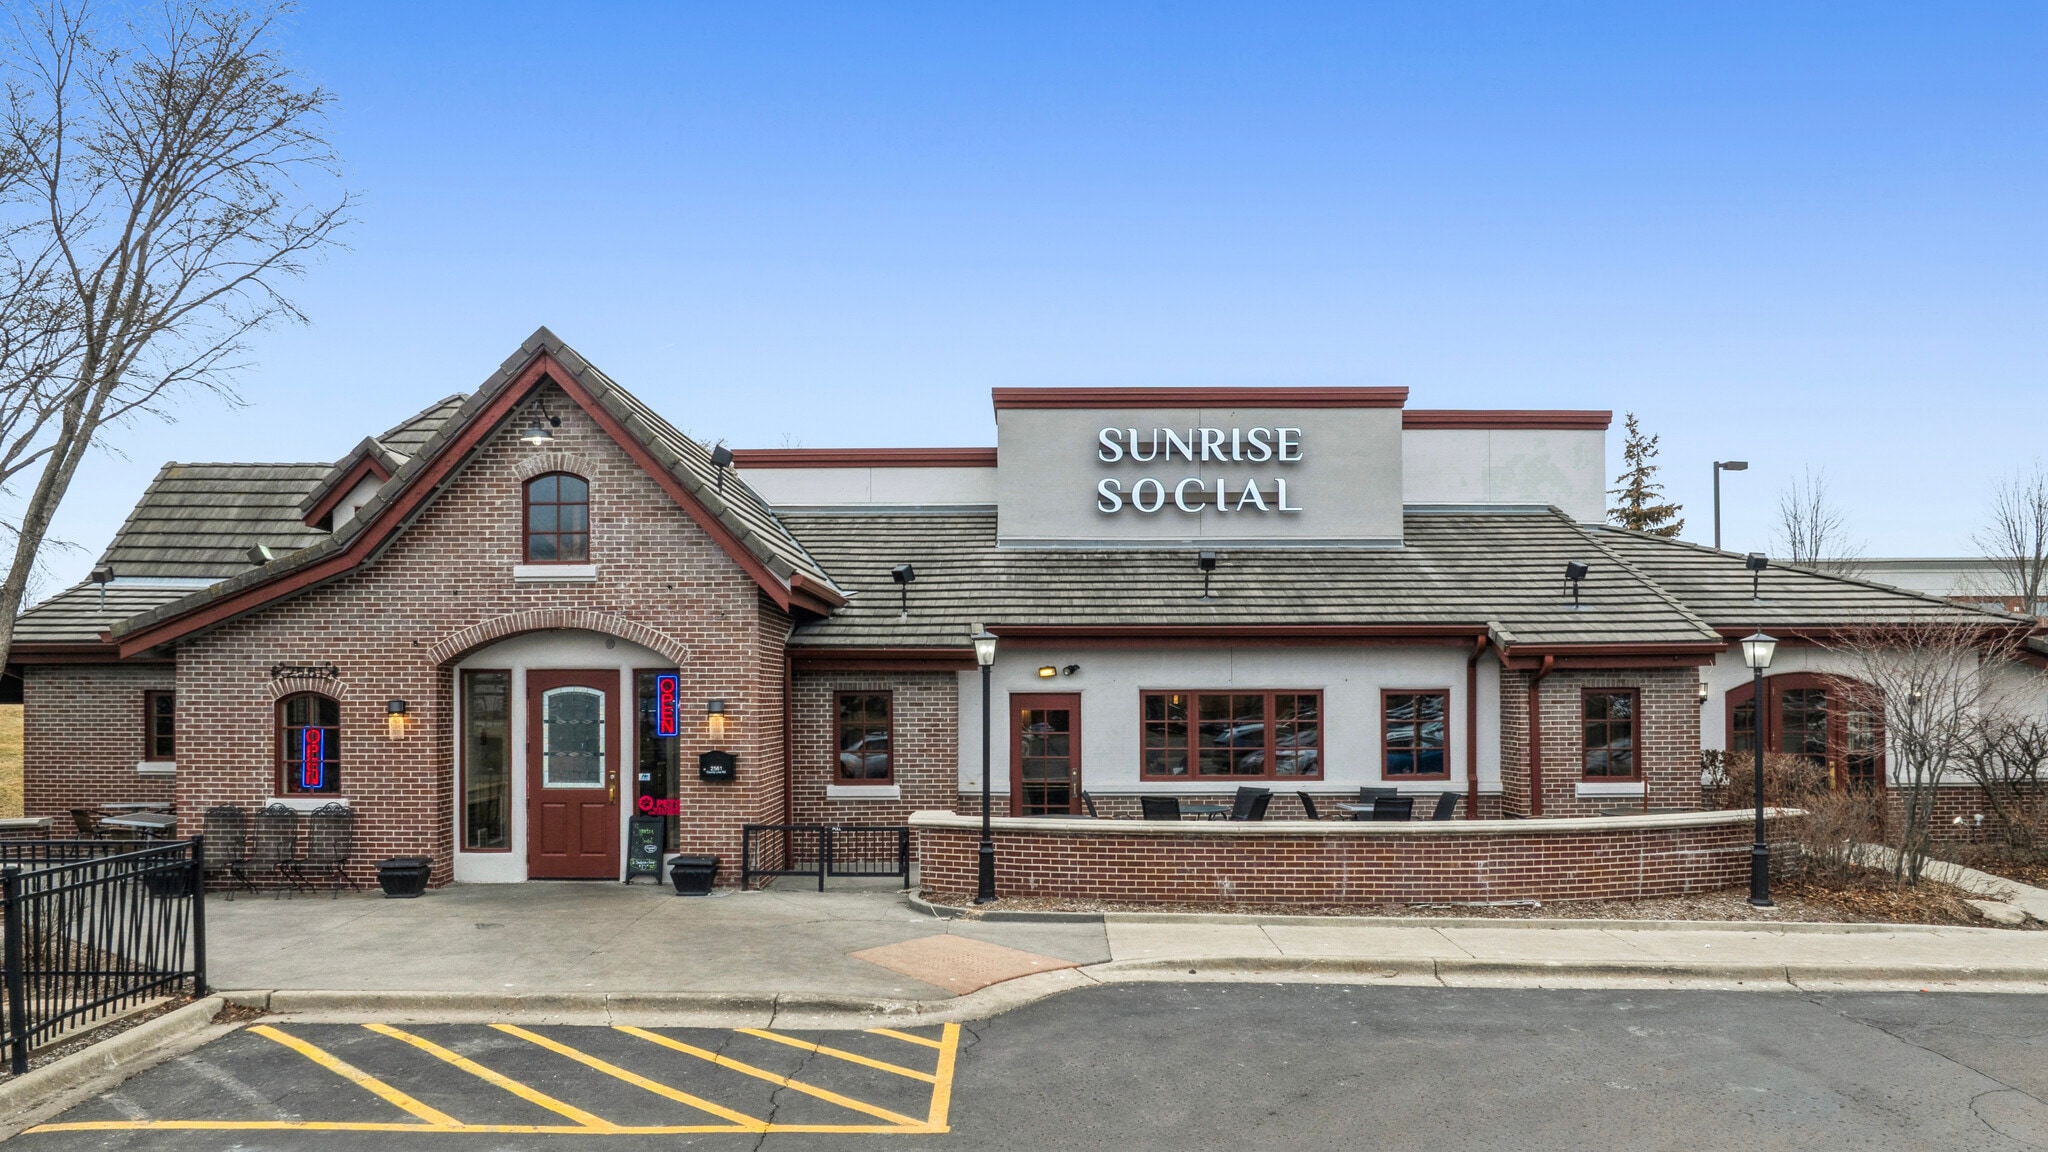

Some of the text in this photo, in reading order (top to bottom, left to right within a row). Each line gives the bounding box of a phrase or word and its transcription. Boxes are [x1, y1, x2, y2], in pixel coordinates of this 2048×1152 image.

[1099, 427, 1304, 462] SUNRISE
[1097, 477, 1303, 513] SOCIAL
[660, 679, 674, 733] OPEN
[306, 729, 321, 785] OPEN
